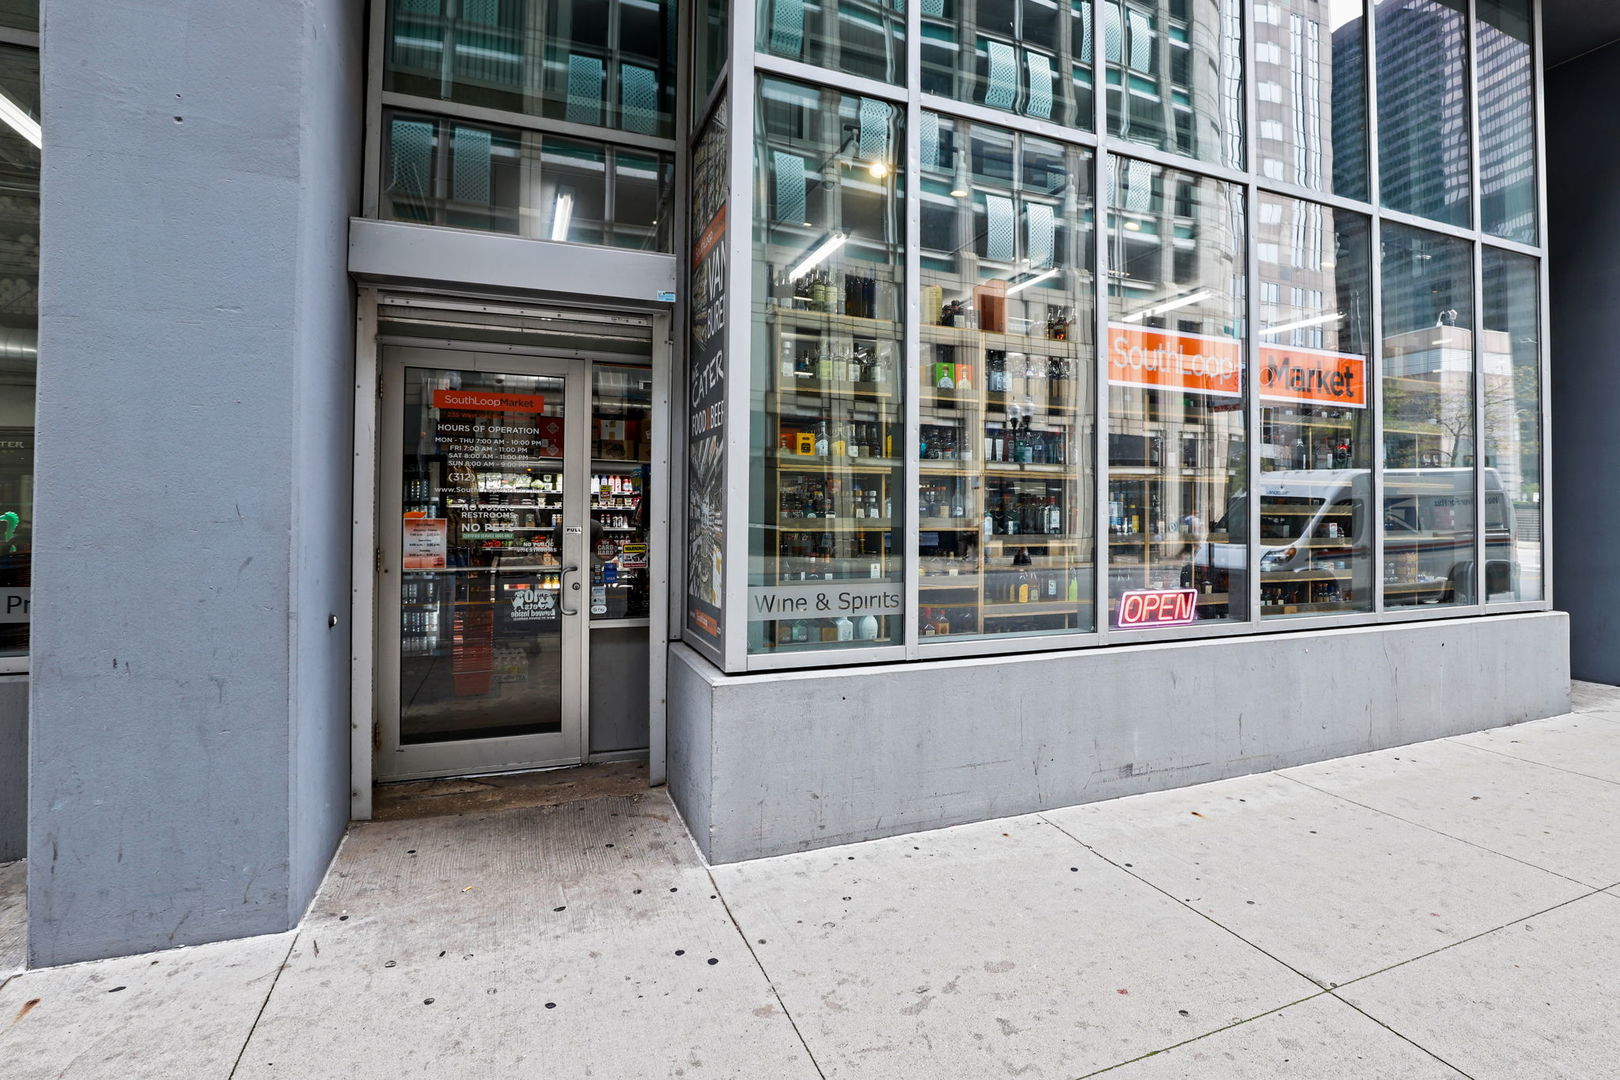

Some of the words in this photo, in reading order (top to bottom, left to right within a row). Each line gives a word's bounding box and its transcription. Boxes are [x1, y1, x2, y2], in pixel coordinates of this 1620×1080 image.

[707, 294, 726, 340] BURE
[692, 350, 724, 408] CATER
[1267, 354, 1354, 398] Market
[437, 424, 470, 432] HOURS
[472, 425, 486, 433] OF
[487, 426, 540, 435] OPERATION
[692, 409, 707, 437] FOOD
[448, 472, 476, 482] (312)
[461, 503, 477, 511] NO
[461, 511, 516, 519] RESTROOMS
[461, 523, 481, 532] NO
[484, 523, 515, 532] PETS
[754, 594, 807, 613] Wine
[815, 592, 831, 611] &
[838, 591, 900, 614] Spirits
[1124, 593, 1193, 623] OPEN
